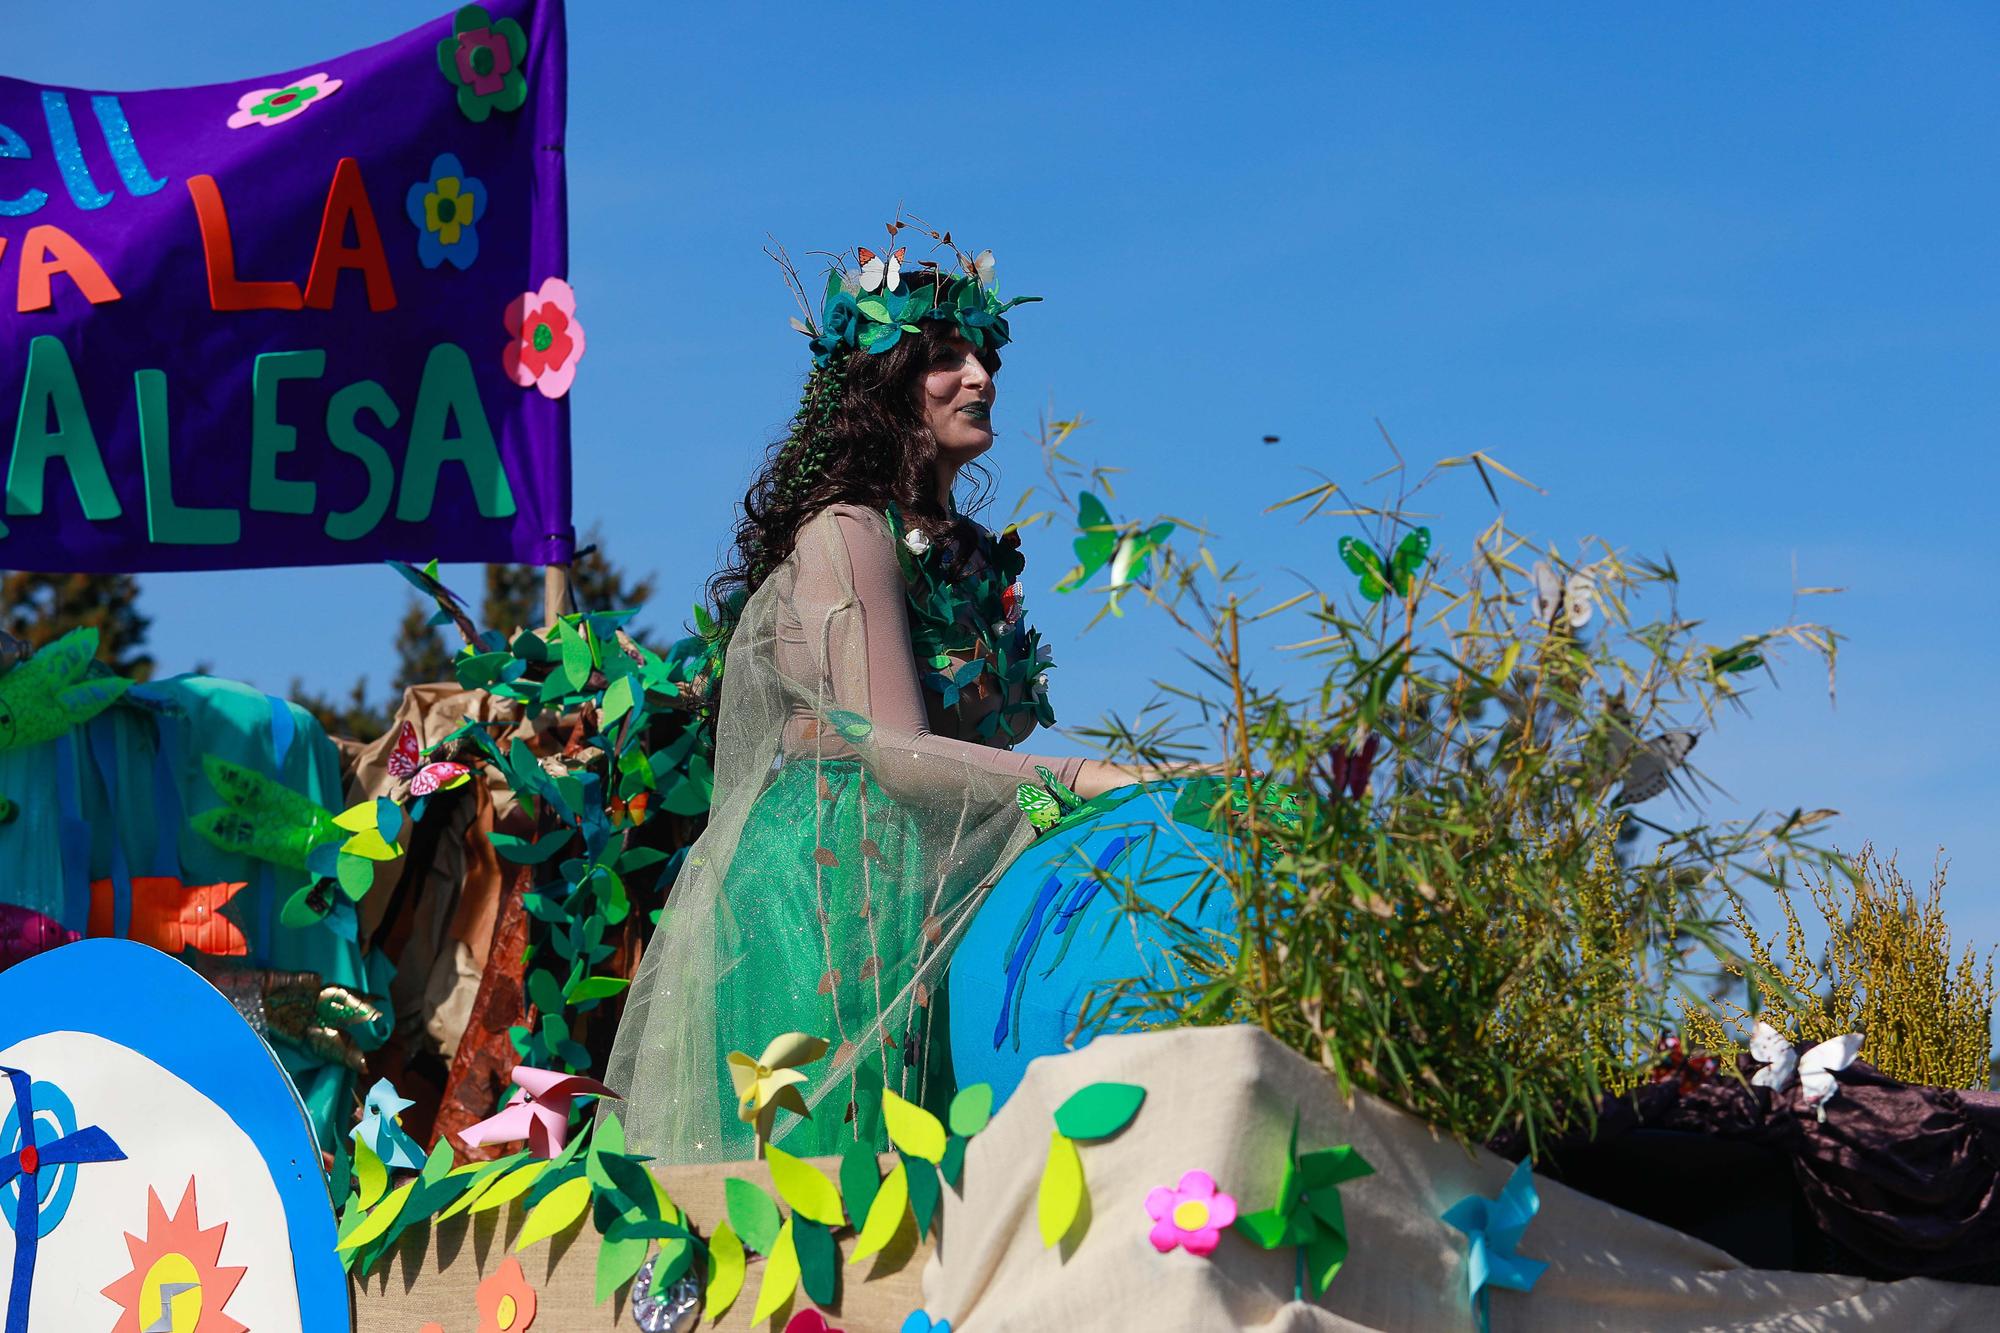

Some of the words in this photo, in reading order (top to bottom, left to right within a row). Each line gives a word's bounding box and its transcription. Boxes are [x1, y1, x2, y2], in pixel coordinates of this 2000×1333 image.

[0, 224, 122, 313] A
[187, 157, 398, 311] LA
[0, 335, 517, 545] ALESA
